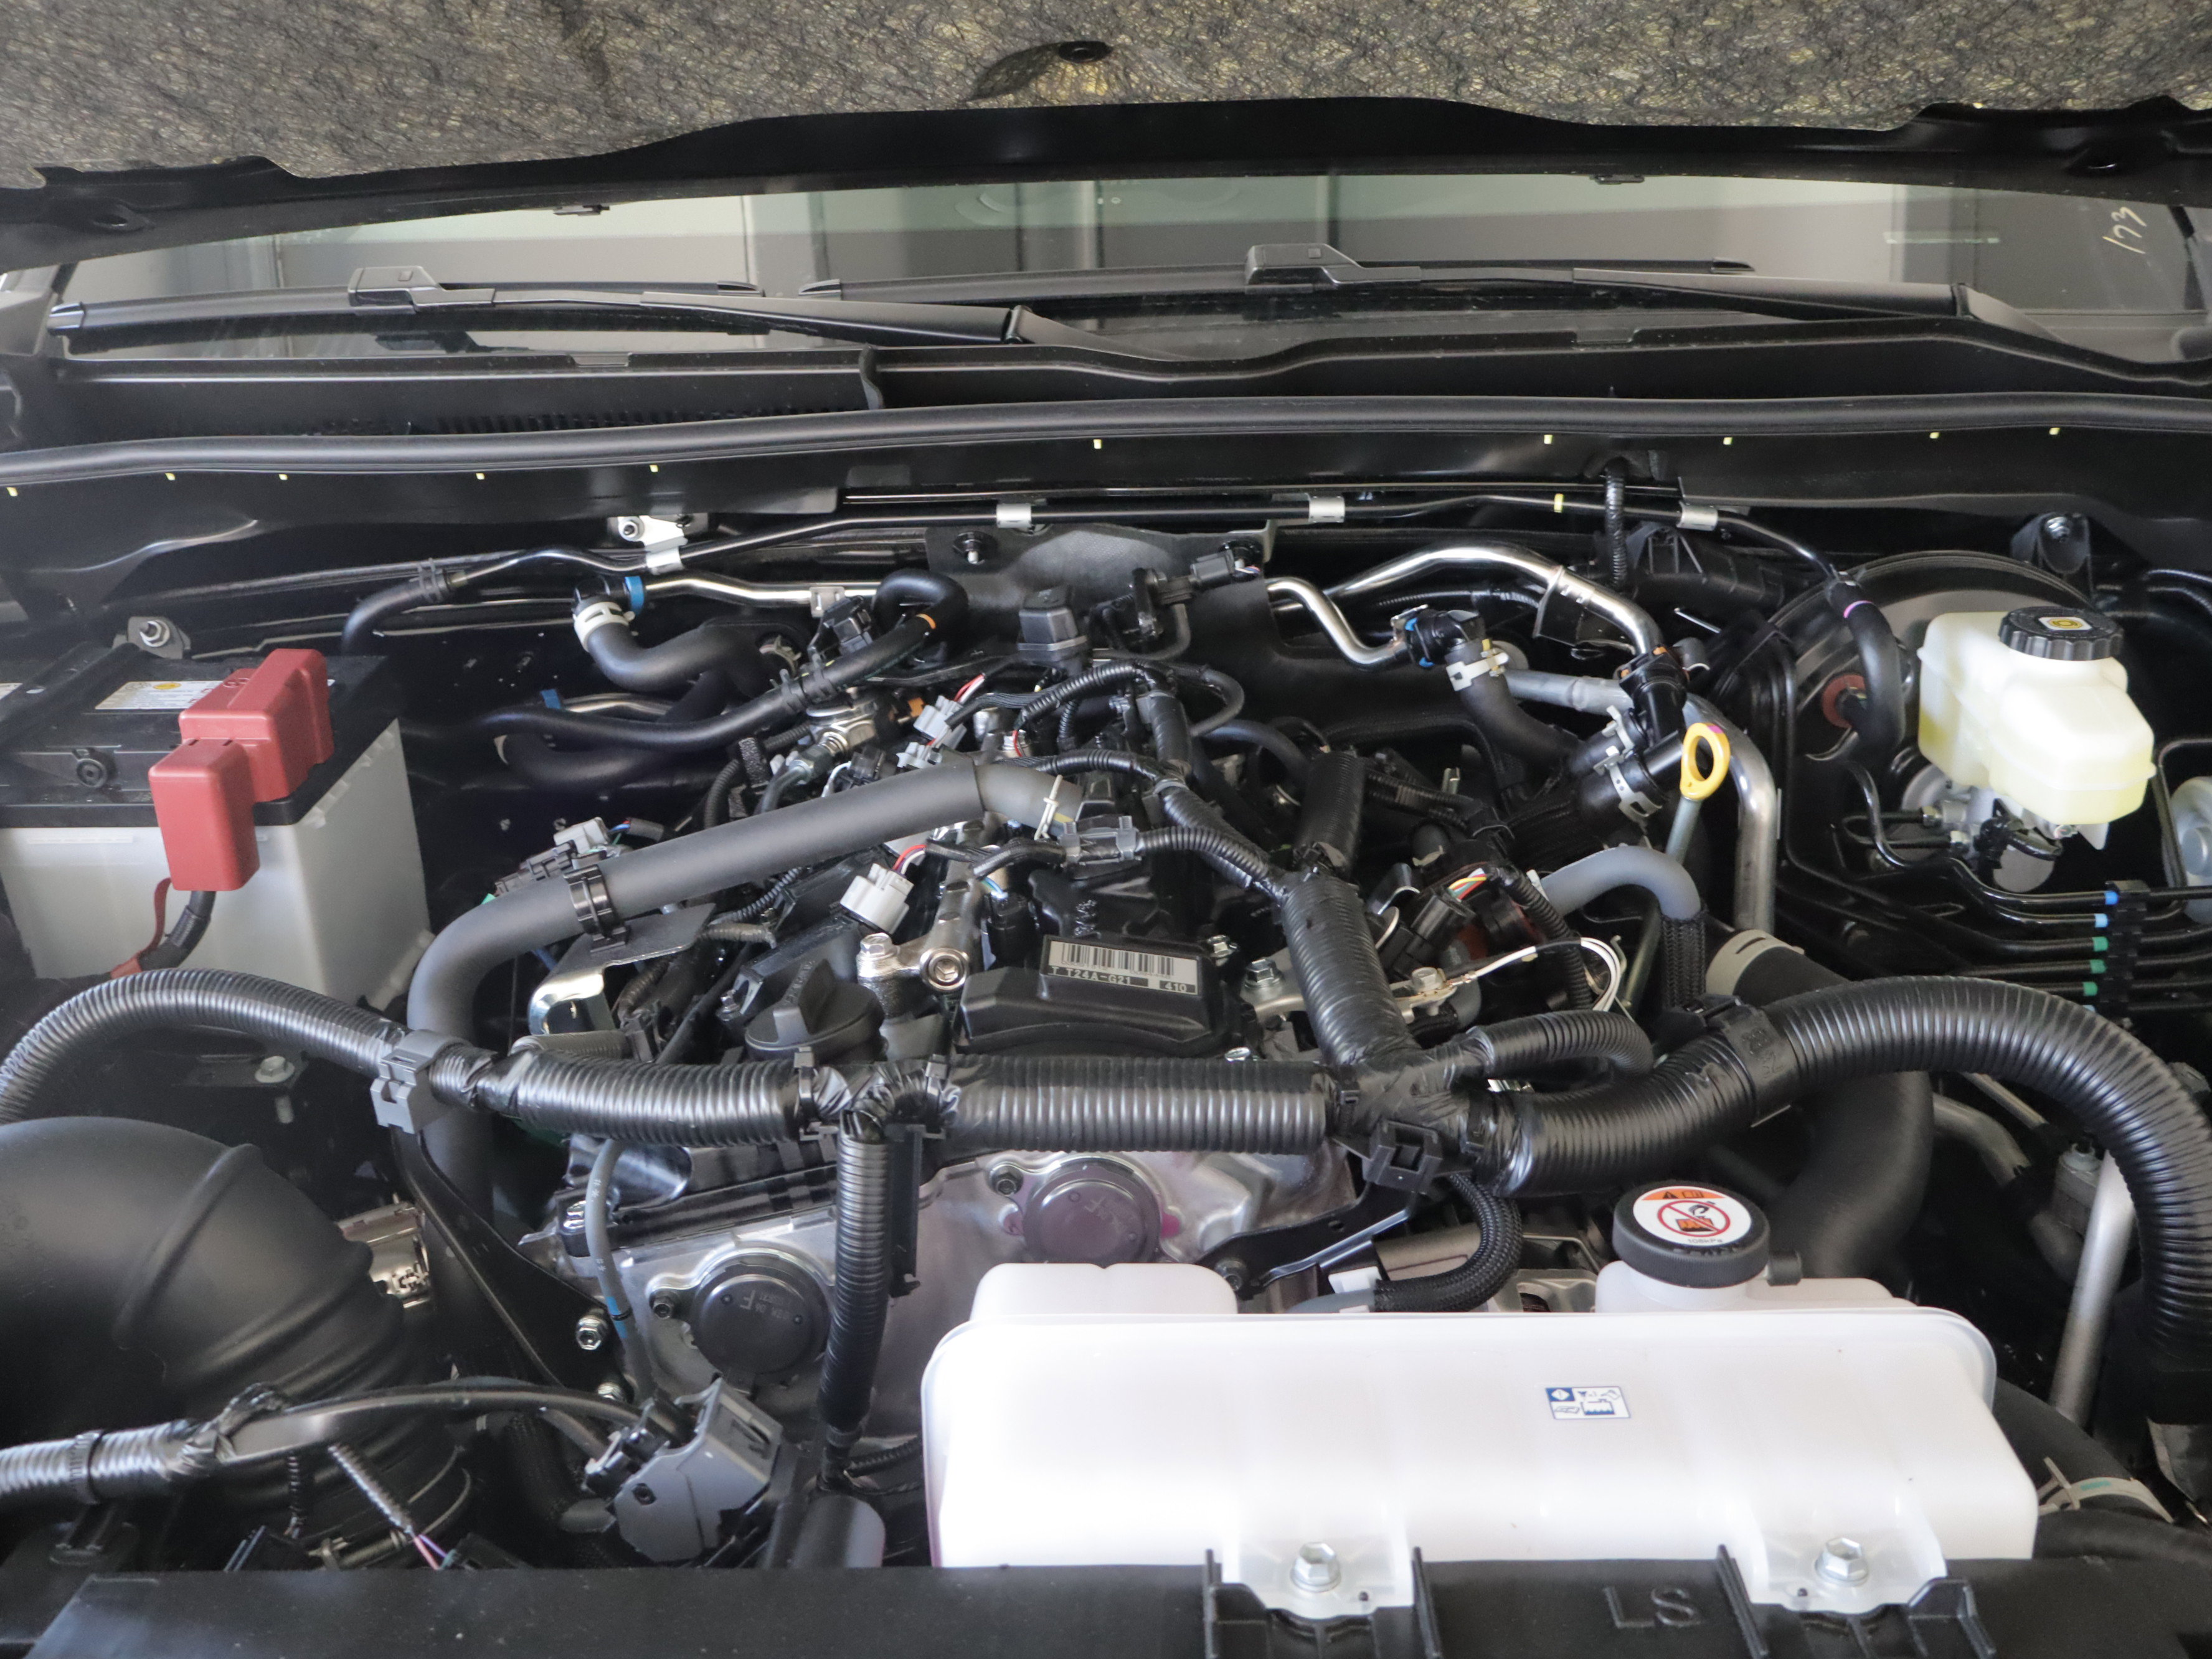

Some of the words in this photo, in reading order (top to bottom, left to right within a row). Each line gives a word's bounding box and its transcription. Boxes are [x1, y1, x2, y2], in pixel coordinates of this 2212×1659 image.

[2102, 206, 2147, 254] 173
[1066, 968, 1131, 985] T24A-G21
[1603, 1586, 1702, 1628] LS
